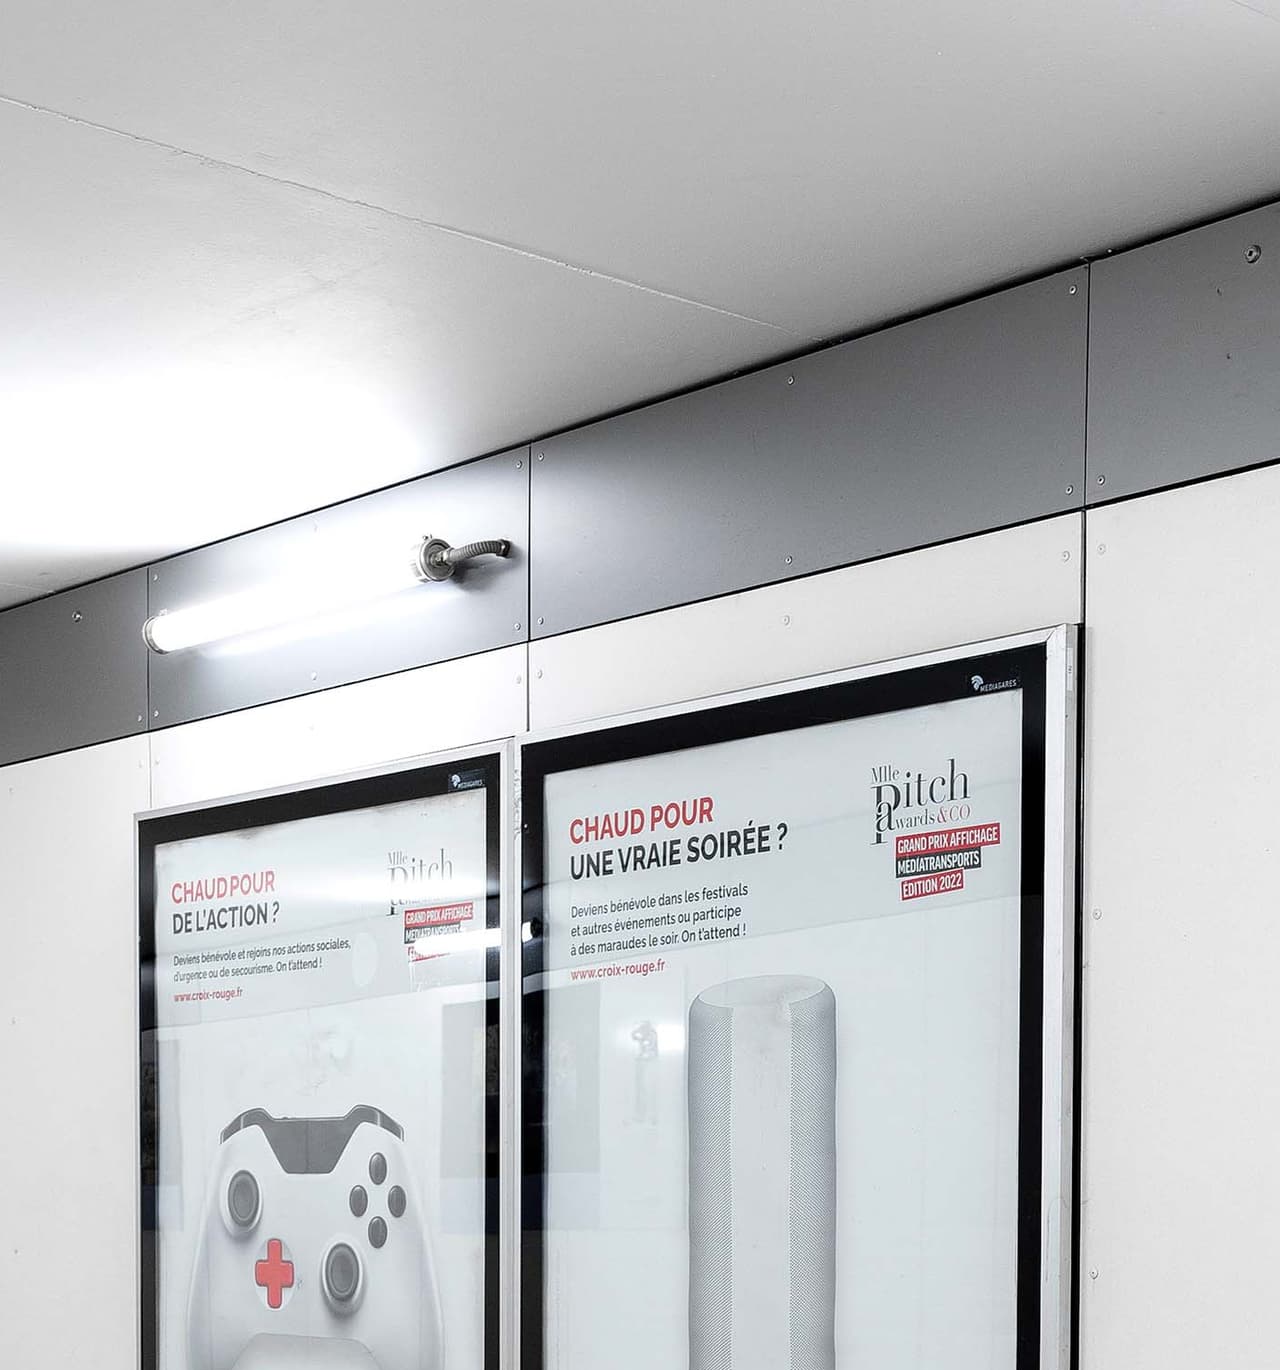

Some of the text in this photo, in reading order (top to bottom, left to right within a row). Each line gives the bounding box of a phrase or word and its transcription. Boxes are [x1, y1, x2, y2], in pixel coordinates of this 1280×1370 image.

[569, 796, 715, 845] CHAUD POUR
[571, 820, 788, 880] UNE VRAIE SOIRÉE ?
[897, 826, 999, 854] GRAND PRIX AFFICHAGE
[171, 870, 276, 905] CHAUD POUR
[571, 883, 748, 919] Deviens bénévole dans les festivals
[902, 872, 962, 898] ÉDITION 2022
[172, 901, 280, 935] DE L'ACTION ?
[570, 905, 742, 937] et autres événements ou participe
[173, 955, 201, 967] Deviens
[201, 950, 236, 964] bénévole
[237, 950, 246, 960] et
[246, 947, 271, 961] rejoins
[272, 946, 286, 957] nos
[287, 942, 315, 955] actions
[570, 923, 747, 956] à des maraudes le soir. On t'attend !
[173, 969, 207, 984] d'urgence
[208, 968, 219, 979] ou
[219, 967, 230, 978] de
[231, 963, 274, 977] secourisme.
[275, 961, 287, 972] On
[288, 958, 318, 971] t'attend
[570, 958, 665, 981] www.croix-rouge.fr
[173, 986, 243, 1002] www.croix-rouge.fr
